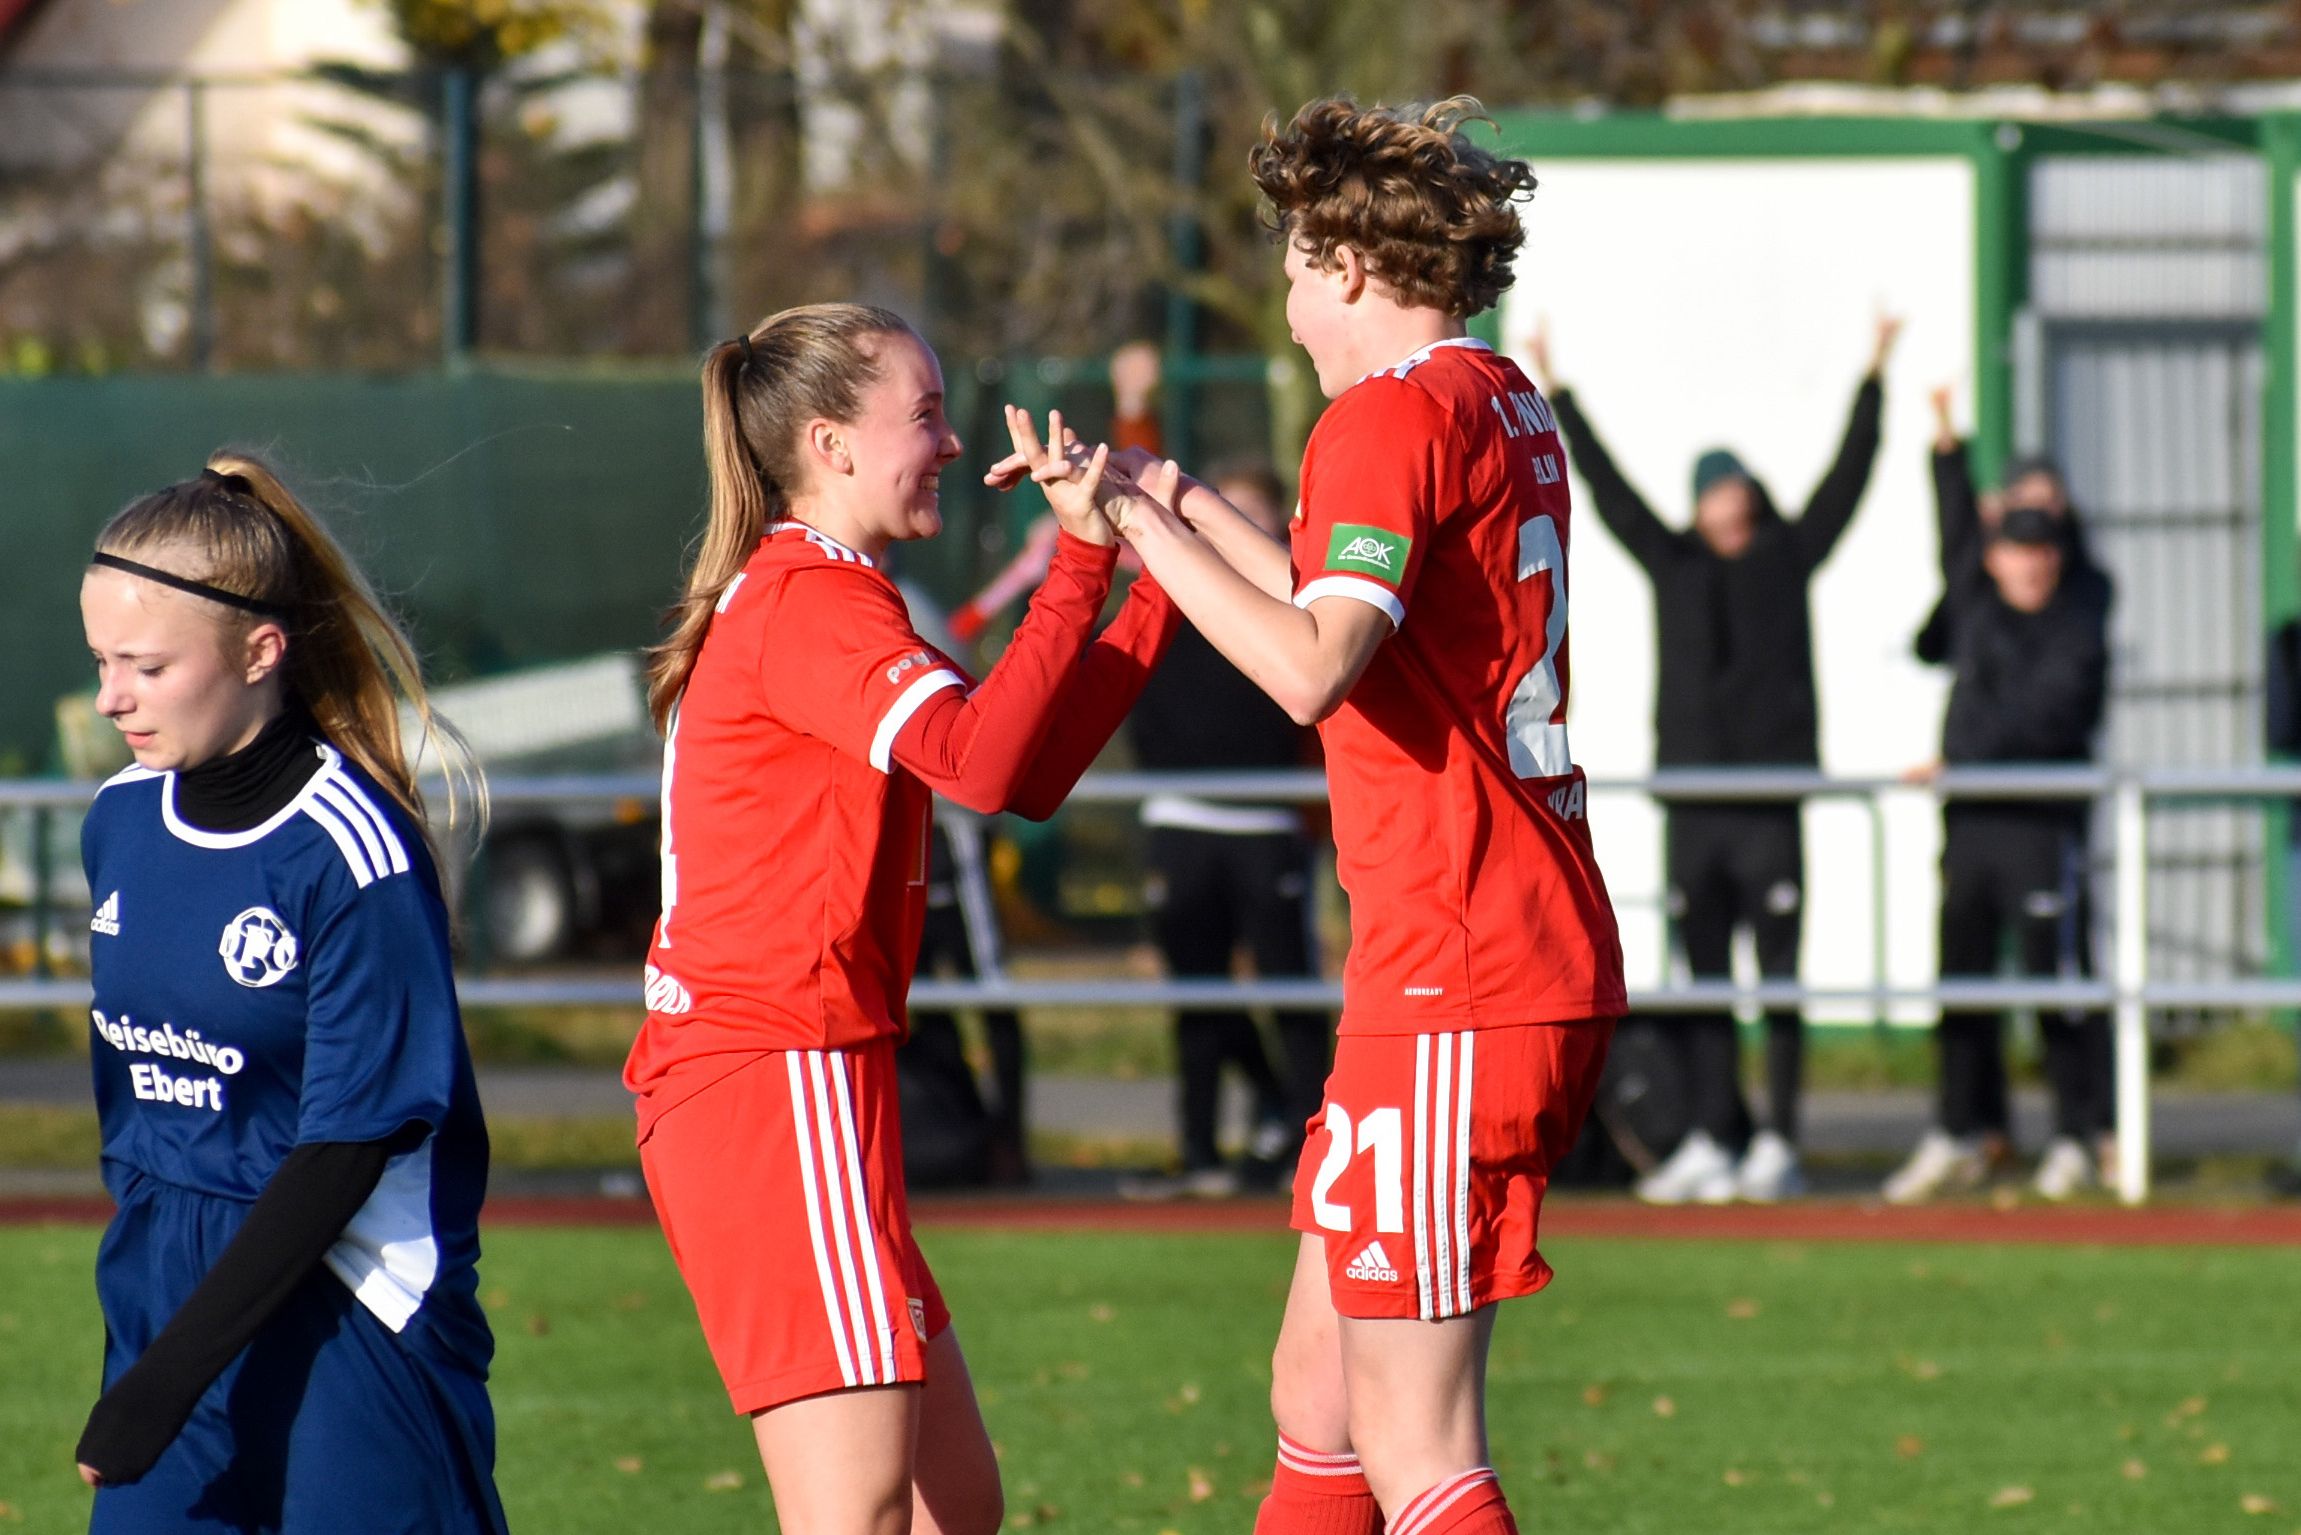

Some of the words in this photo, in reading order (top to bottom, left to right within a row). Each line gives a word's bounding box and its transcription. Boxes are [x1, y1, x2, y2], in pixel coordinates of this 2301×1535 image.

[1341, 536, 1395, 566] AOK
[90, 918, 120, 937] adidas
[91, 1009, 244, 1076] Reisebüro
[128, 1063, 223, 1112] Ebert
[1311, 1102, 1404, 1234] 21
[1346, 1266, 1398, 1282] adidas
